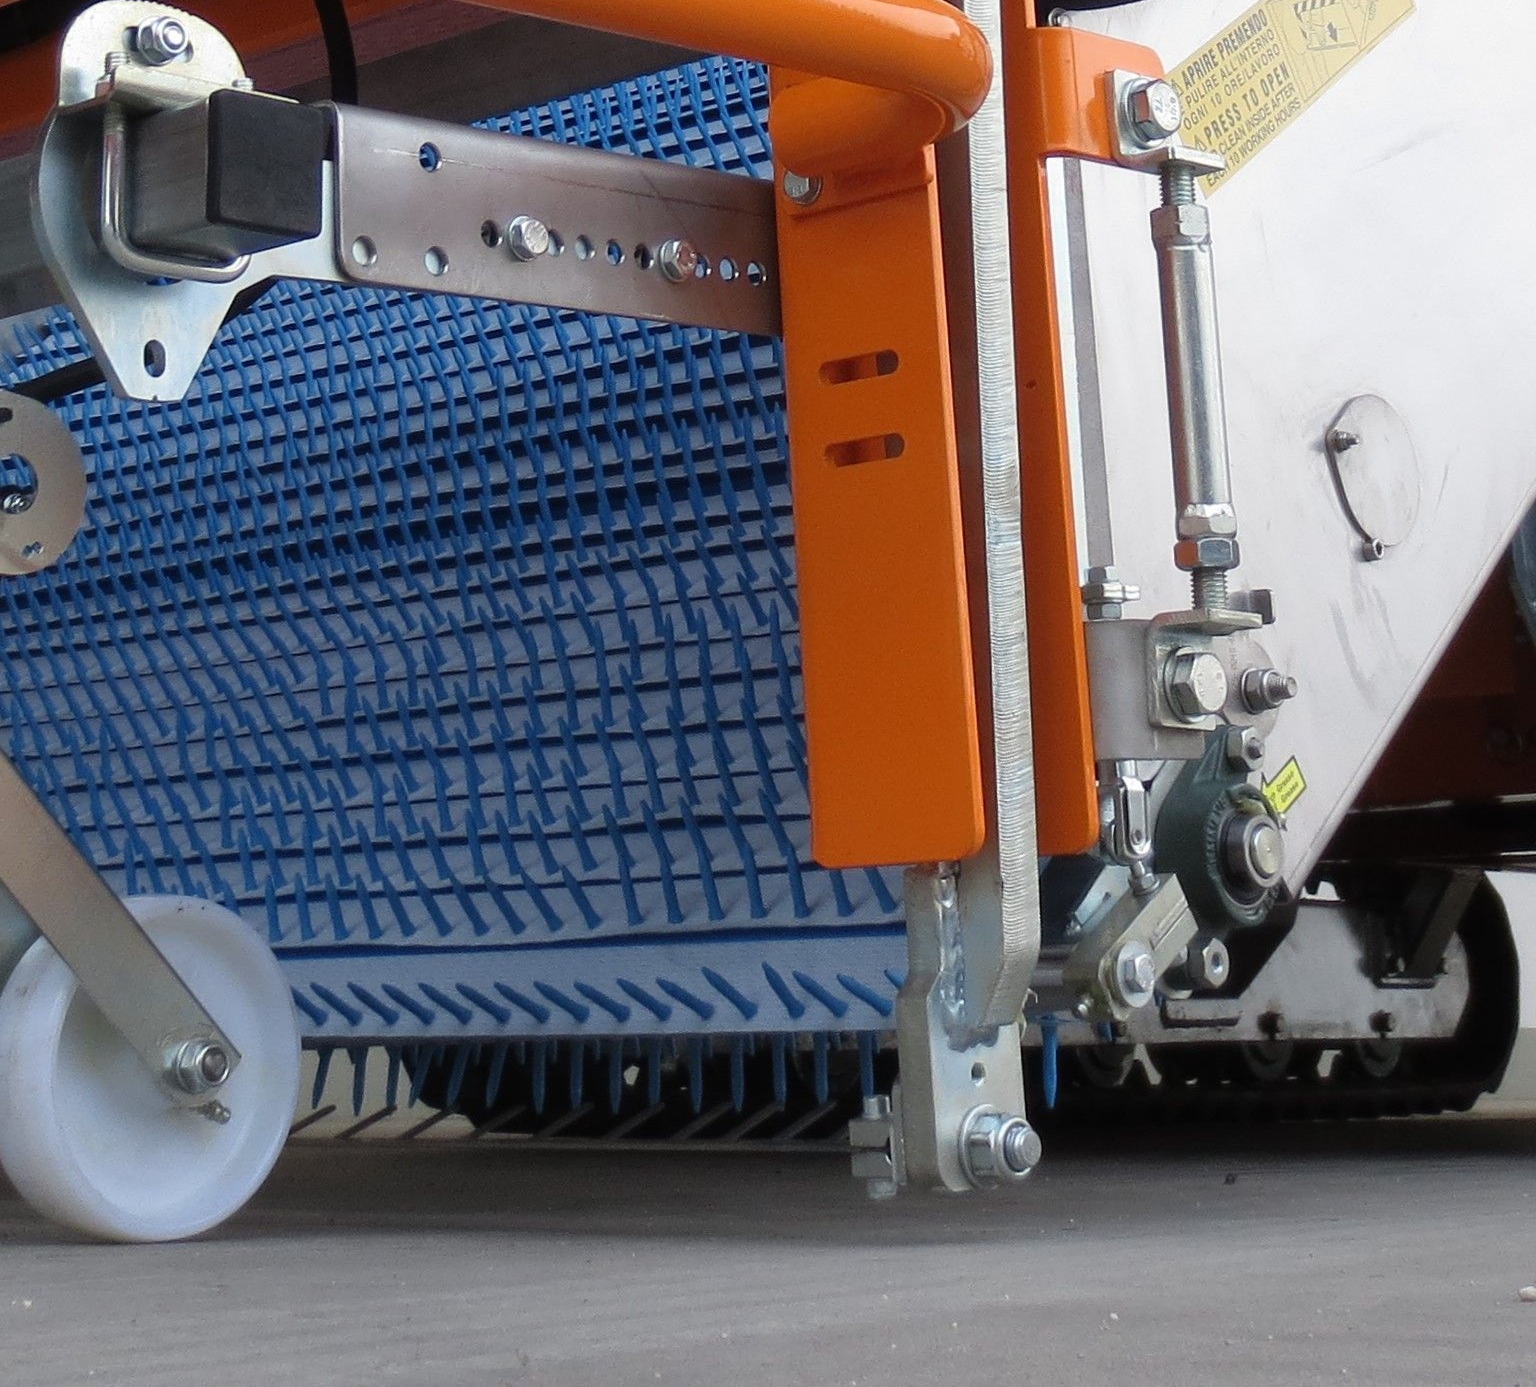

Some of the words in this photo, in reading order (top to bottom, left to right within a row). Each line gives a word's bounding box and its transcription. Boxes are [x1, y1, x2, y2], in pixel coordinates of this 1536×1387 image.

[1181, 48, 1219, 90] APRIRE
[1216, 9, 1268, 60] PREMENDO
[1183, 104, 1209, 131] OGNI
[1210, 92, 1222, 108] 10
[1224, 43, 1281, 97] ORE/LAVORO
[1185, 73, 1219, 108] PULIRE
[1219, 29, 1275, 81] ALL'INTERNO
[1204, 103, 1242, 146] PRESS
[1242, 88, 1259, 112] TO
[1260, 62, 1290, 97] OPEN
[1219, 125, 1247, 155] CLEAN
[1244, 103, 1272, 132] INSIDE
[1270, 82, 1297, 111] AFTER
[1229, 155, 1242, 167] 10
[1238, 120, 1276, 155] WORKING
[1274, 97, 1302, 126] HOURS
